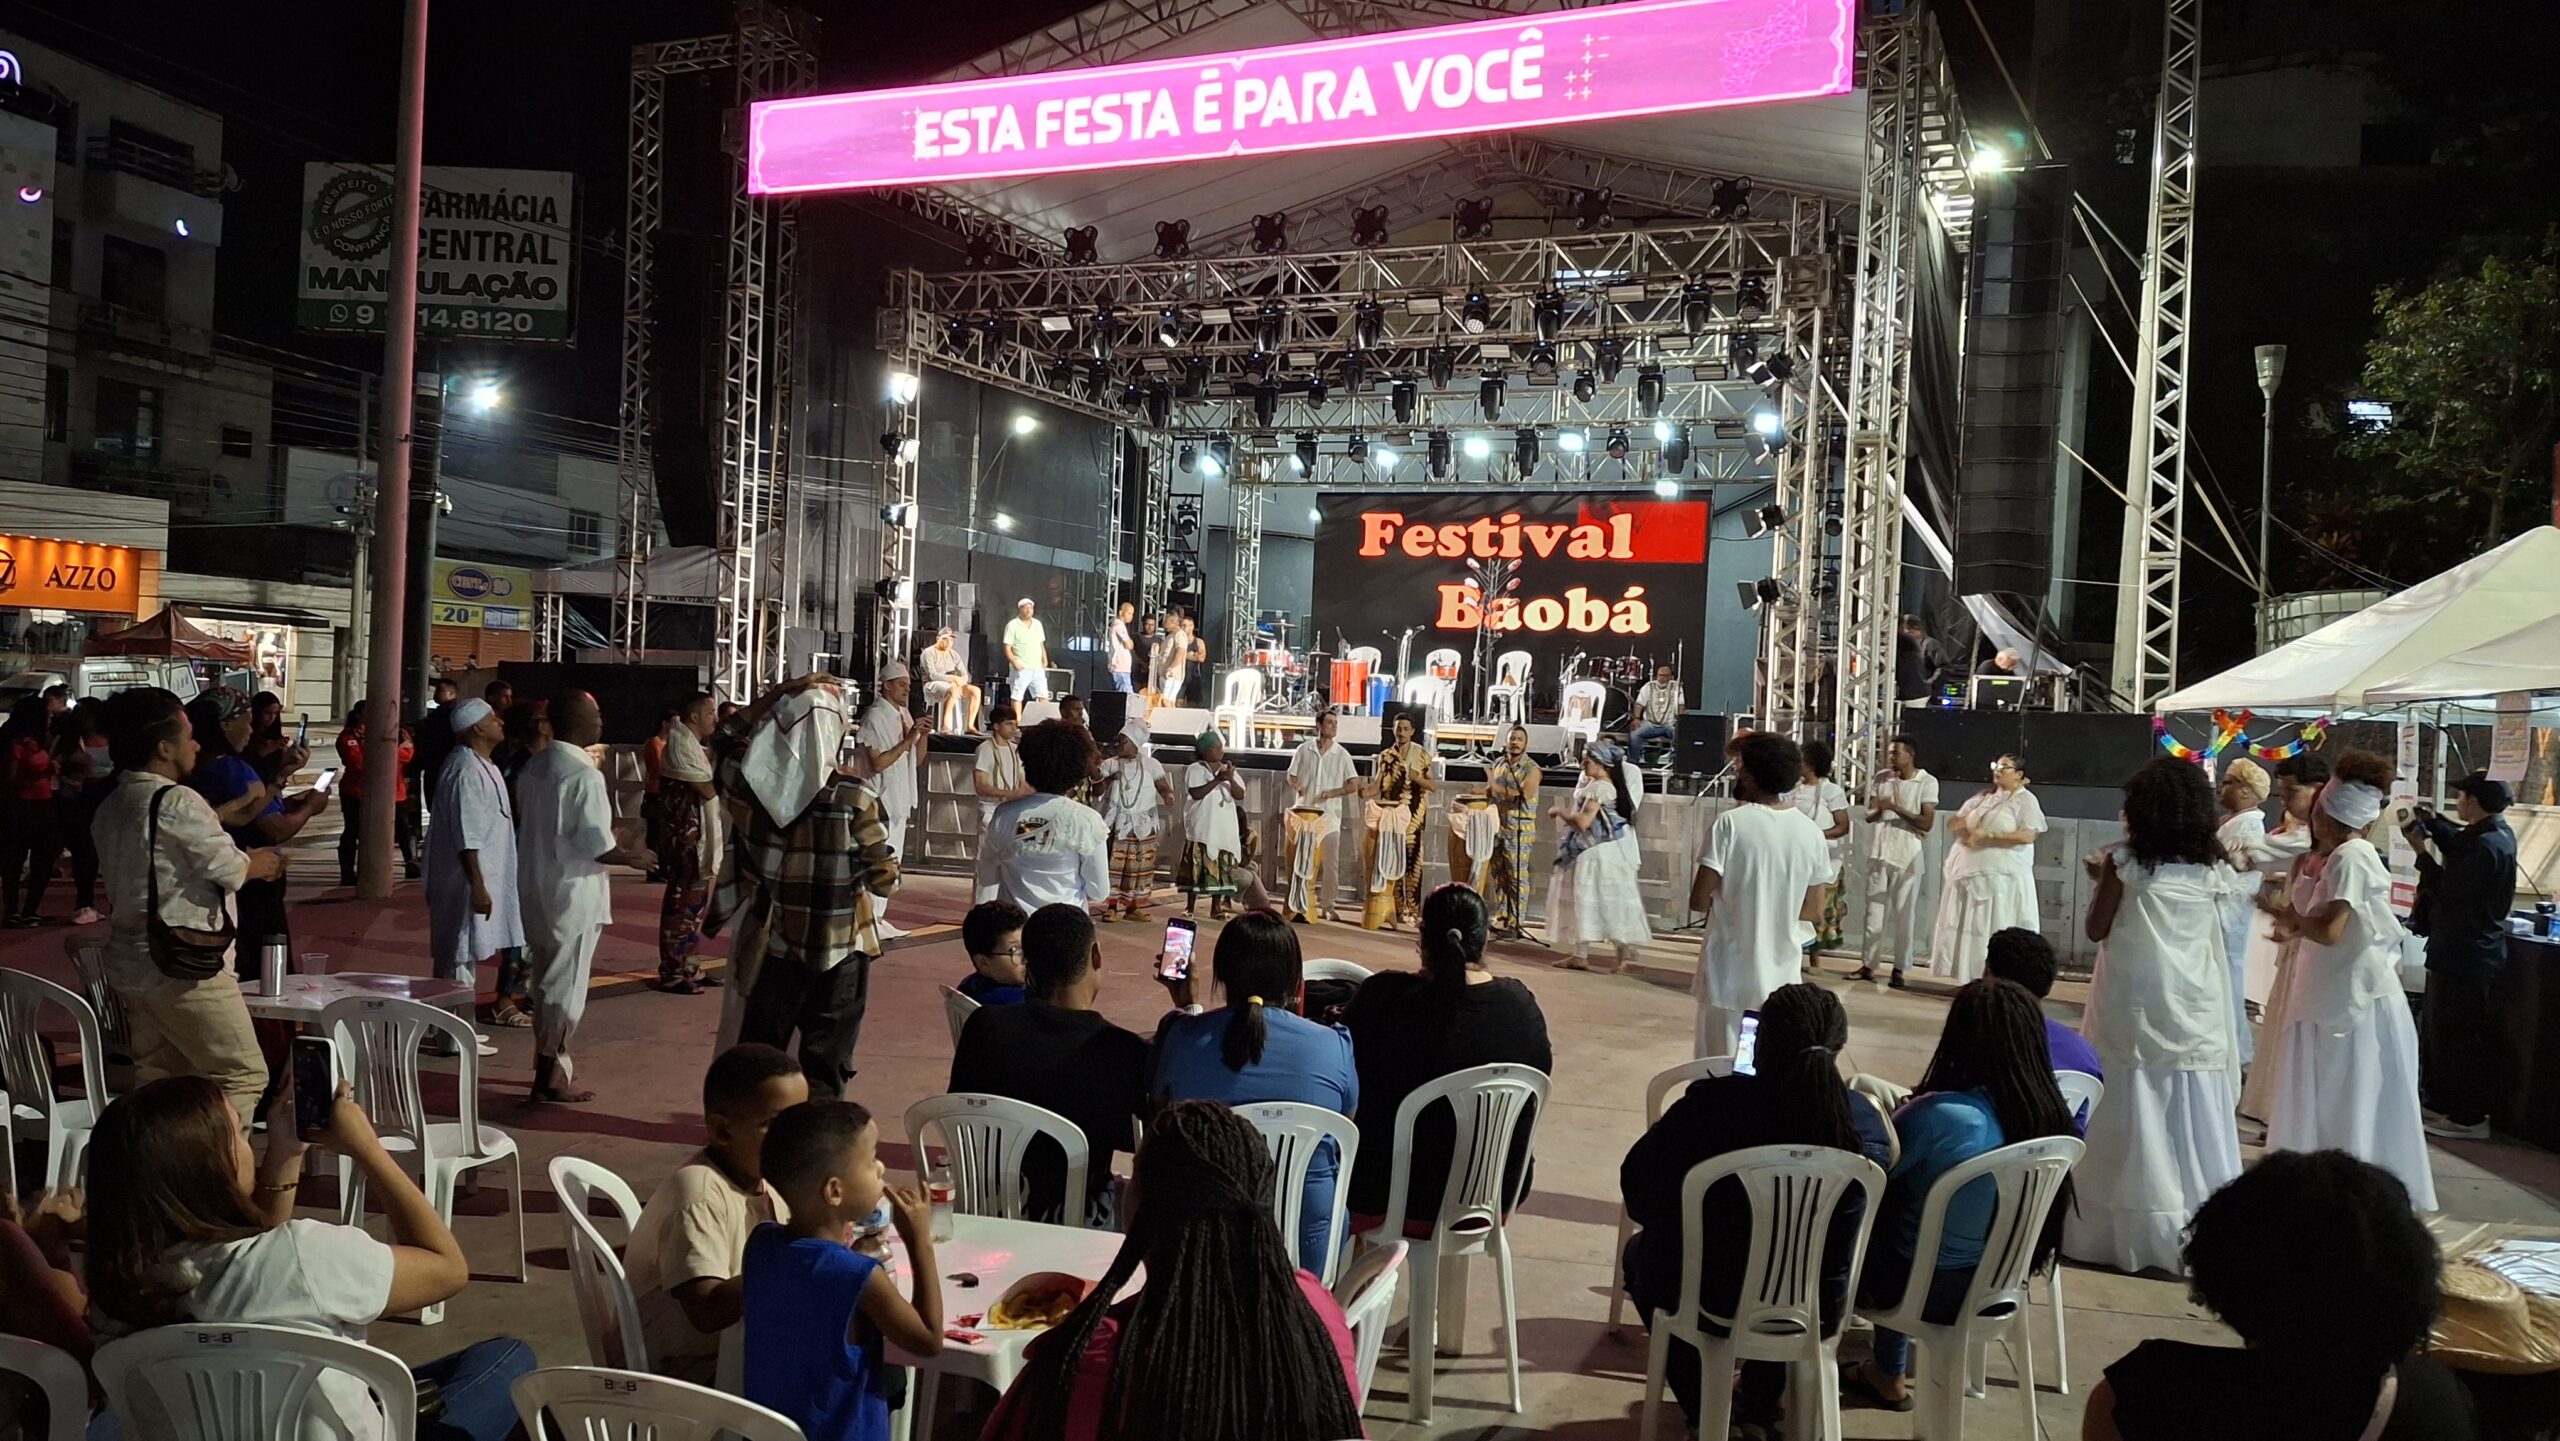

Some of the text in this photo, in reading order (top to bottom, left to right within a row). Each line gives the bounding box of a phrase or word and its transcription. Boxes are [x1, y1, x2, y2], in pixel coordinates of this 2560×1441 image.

[914, 26, 1545, 158] ESTA FESTA É PARA VOCÊ
[321, 179, 377, 214] RESPEITO
[331, 209, 364, 231] NOSSO
[308, 266, 557, 303] MANULAÇÃO
[355, 304, 375, 325] 9
[1359, 512, 1635, 559] Festival
[44, 564, 116, 592] AZZO
[442, 606, 469, 624] 20
[1436, 585, 1651, 634] Baobá
